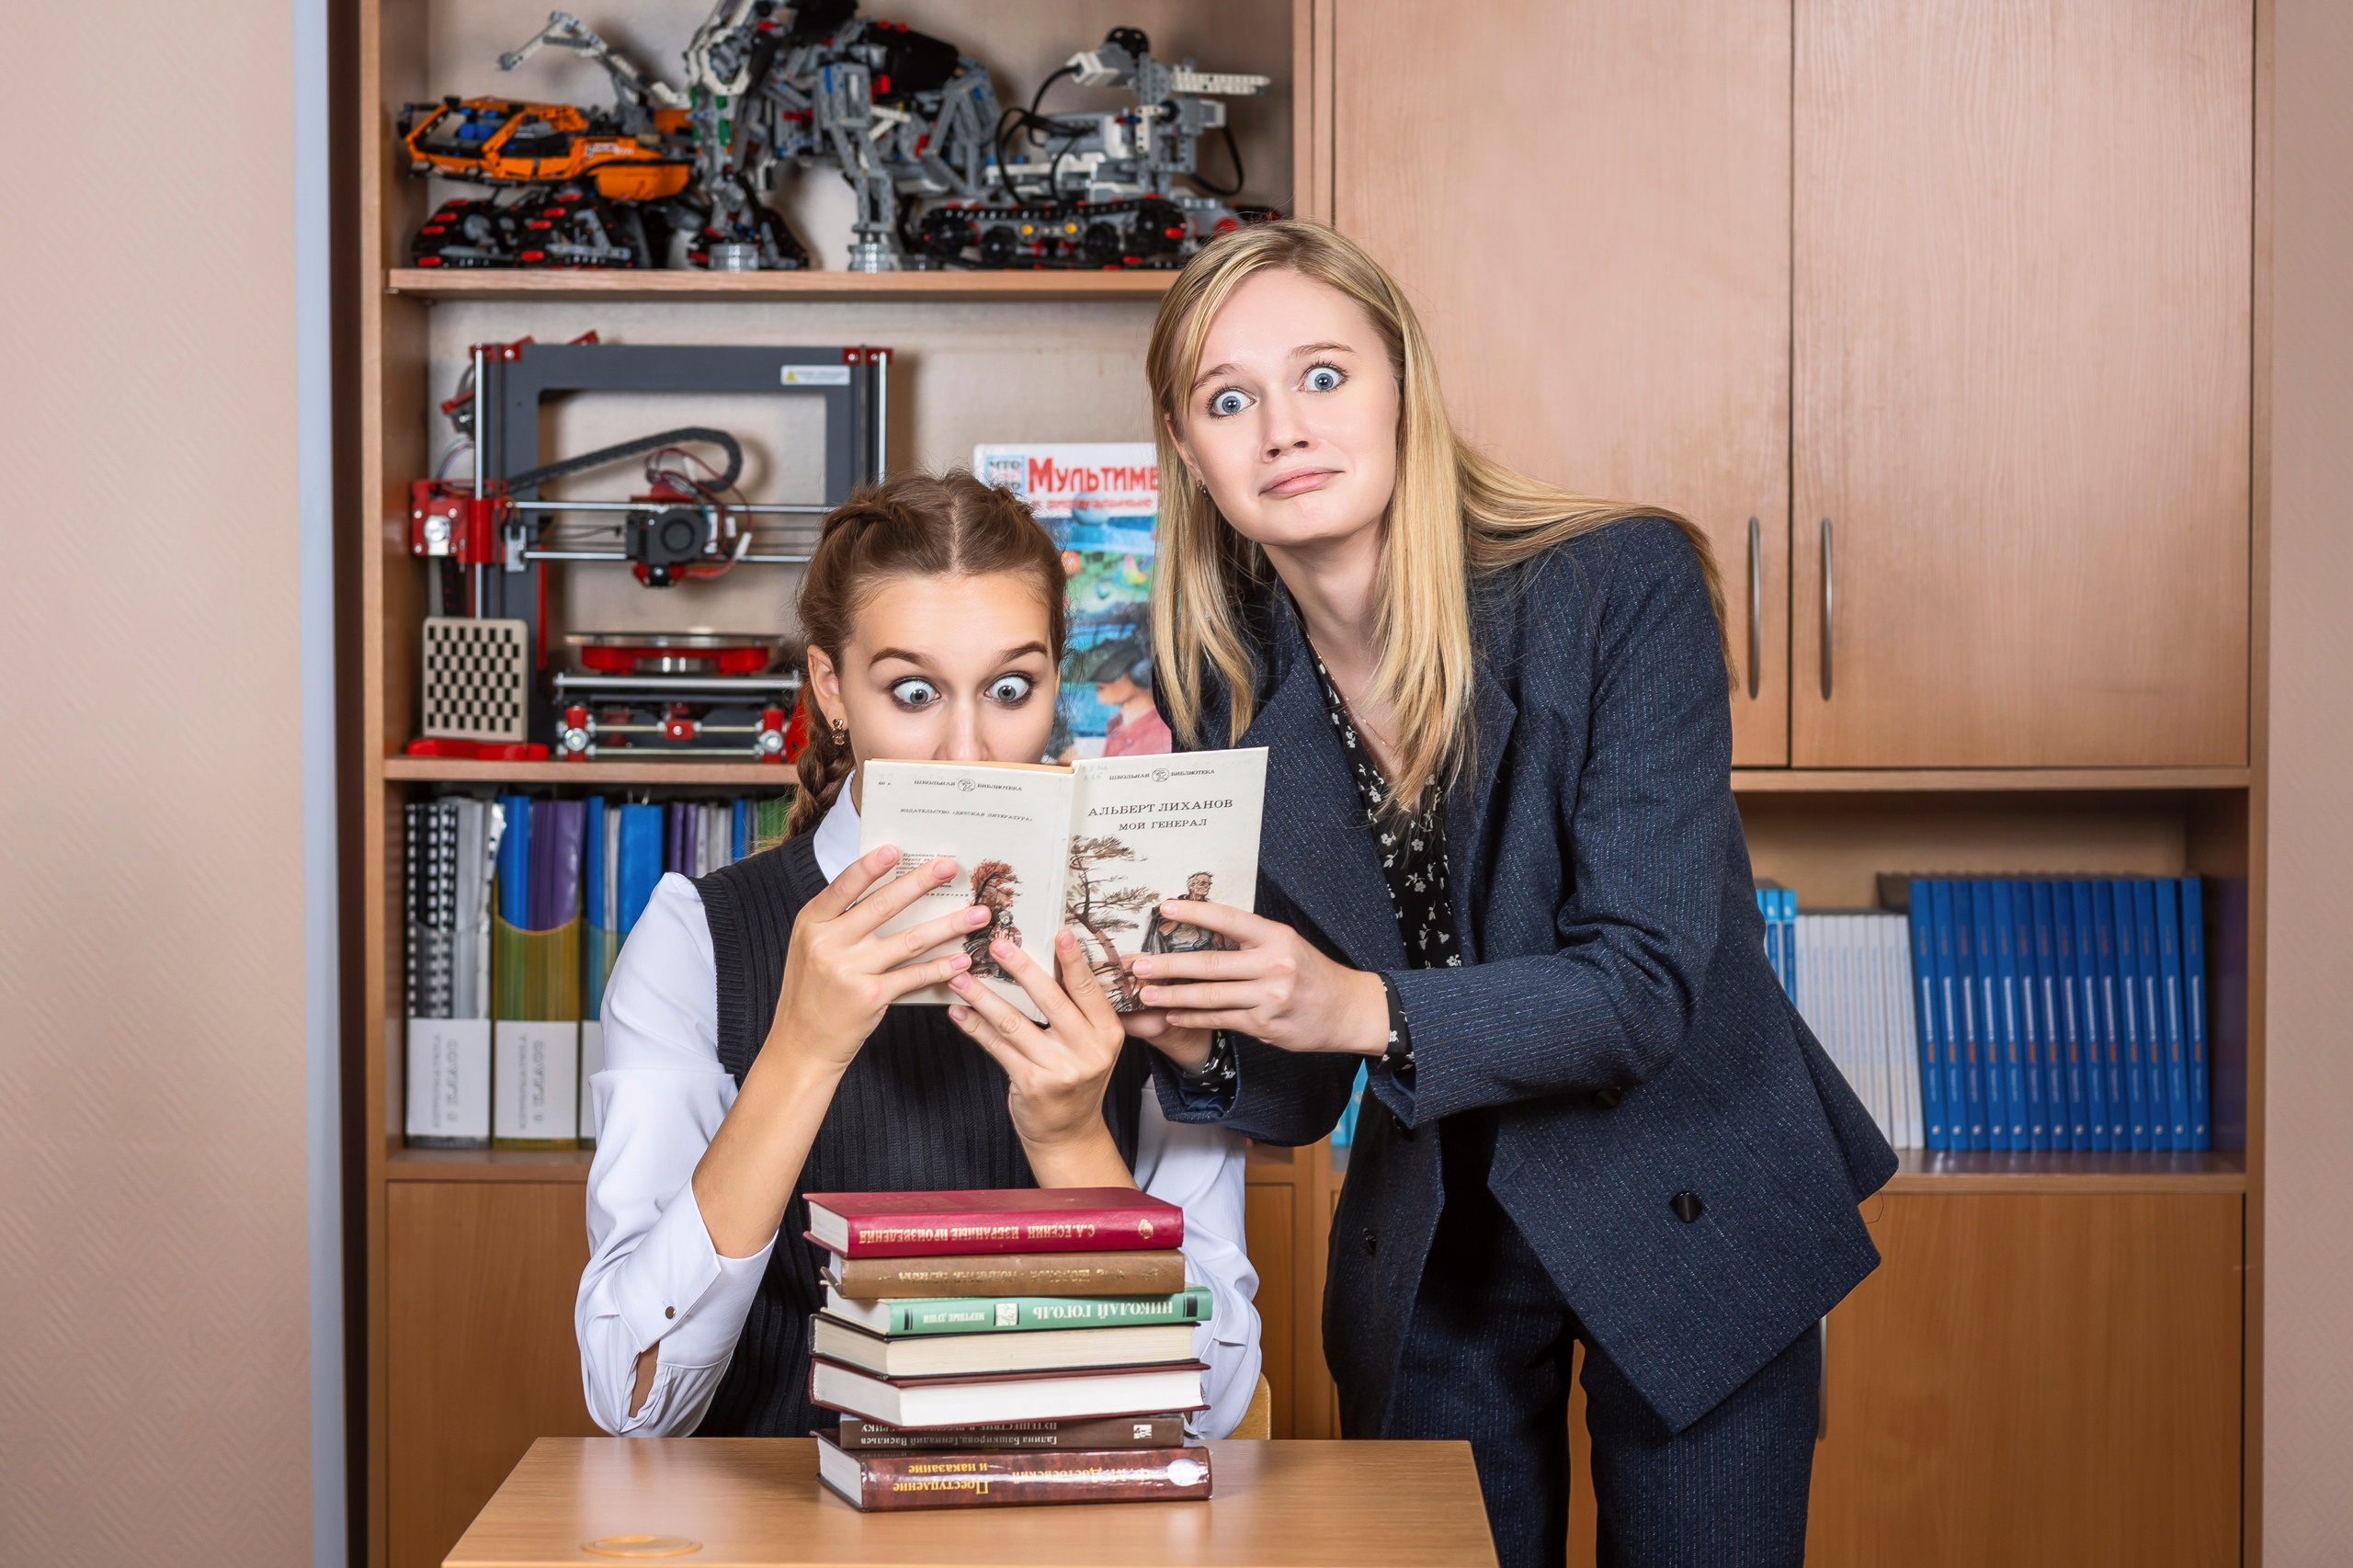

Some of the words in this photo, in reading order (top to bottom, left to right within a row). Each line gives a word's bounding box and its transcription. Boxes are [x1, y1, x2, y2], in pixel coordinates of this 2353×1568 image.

[1171, 769, 1215, 778] БИБЛИОТЕКА
[977, 783, 1022, 791] БИБЛИОТЕКА
[1088, 803, 1155, 817] АЛЬБЕРТ
[1158, 799, 1233, 812] ЛИХАНОВ
[1151, 818, 1208, 829] ГЕНЕРАЛ
[859, 1229, 949, 1244] ПРОИЗВЕДЕНИЯ
[950, 1226, 1019, 1241] ИЗБРАННЫЕ
[1032, 1303, 1091, 1320] ГОГОЛЬ
[1097, 1301, 1174, 1319] НИКОЛАЙ
[923, 1312, 947, 1324] ДУШИ
[948, 1312, 985, 1323] МЕРТВЫЕ
[860, 1437, 907, 1446] Васильев
[910, 1437, 959, 1446] Геннадий
[1023, 1436, 1057, 1445] Галина
[908, 1463, 978, 1474] наказание
[980, 1462, 989, 1471] и
[1012, 1467, 1102, 1484] Достоевский
[892, 1482, 989, 1494] Преступление
